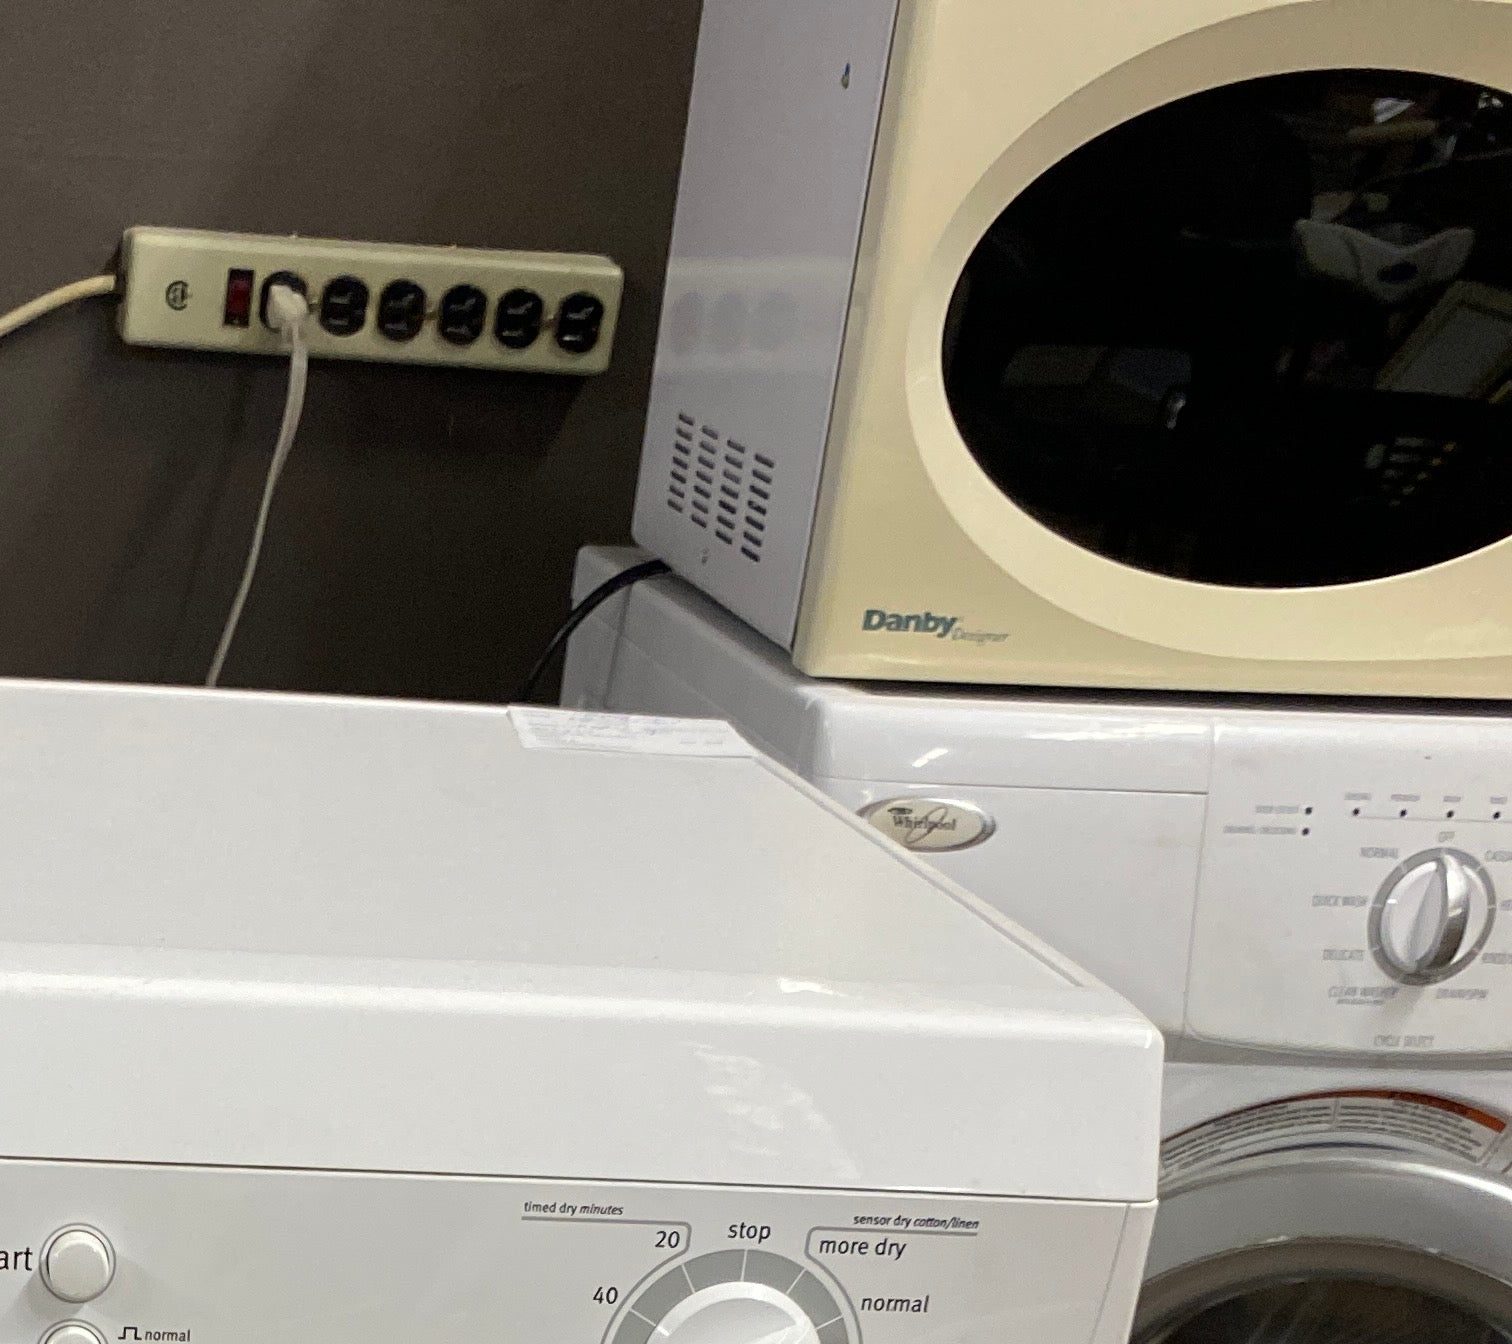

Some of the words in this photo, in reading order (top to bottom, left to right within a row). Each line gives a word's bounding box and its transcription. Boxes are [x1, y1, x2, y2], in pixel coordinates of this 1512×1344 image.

[862, 609, 957, 638] Danby
[892, 813, 957, 832] Whirlpool
[524, 1202, 556, 1213] timed
[559, 1203, 578, 1216] dry
[580, 1204, 623, 1215] minutes
[853, 1215, 890, 1226] sensor
[893, 1215, 912, 1229] dry
[913, 1216, 979, 1230] cotton/linen
[655, 1231, 680, 1249] 20
[728, 1221, 772, 1244] stop
[819, 1239, 869, 1255] more
[875, 1238, 907, 1260] dry
[593, 1286, 618, 1305] 40
[861, 1295, 930, 1314] normal
[144, 1329, 191, 1343] normal
